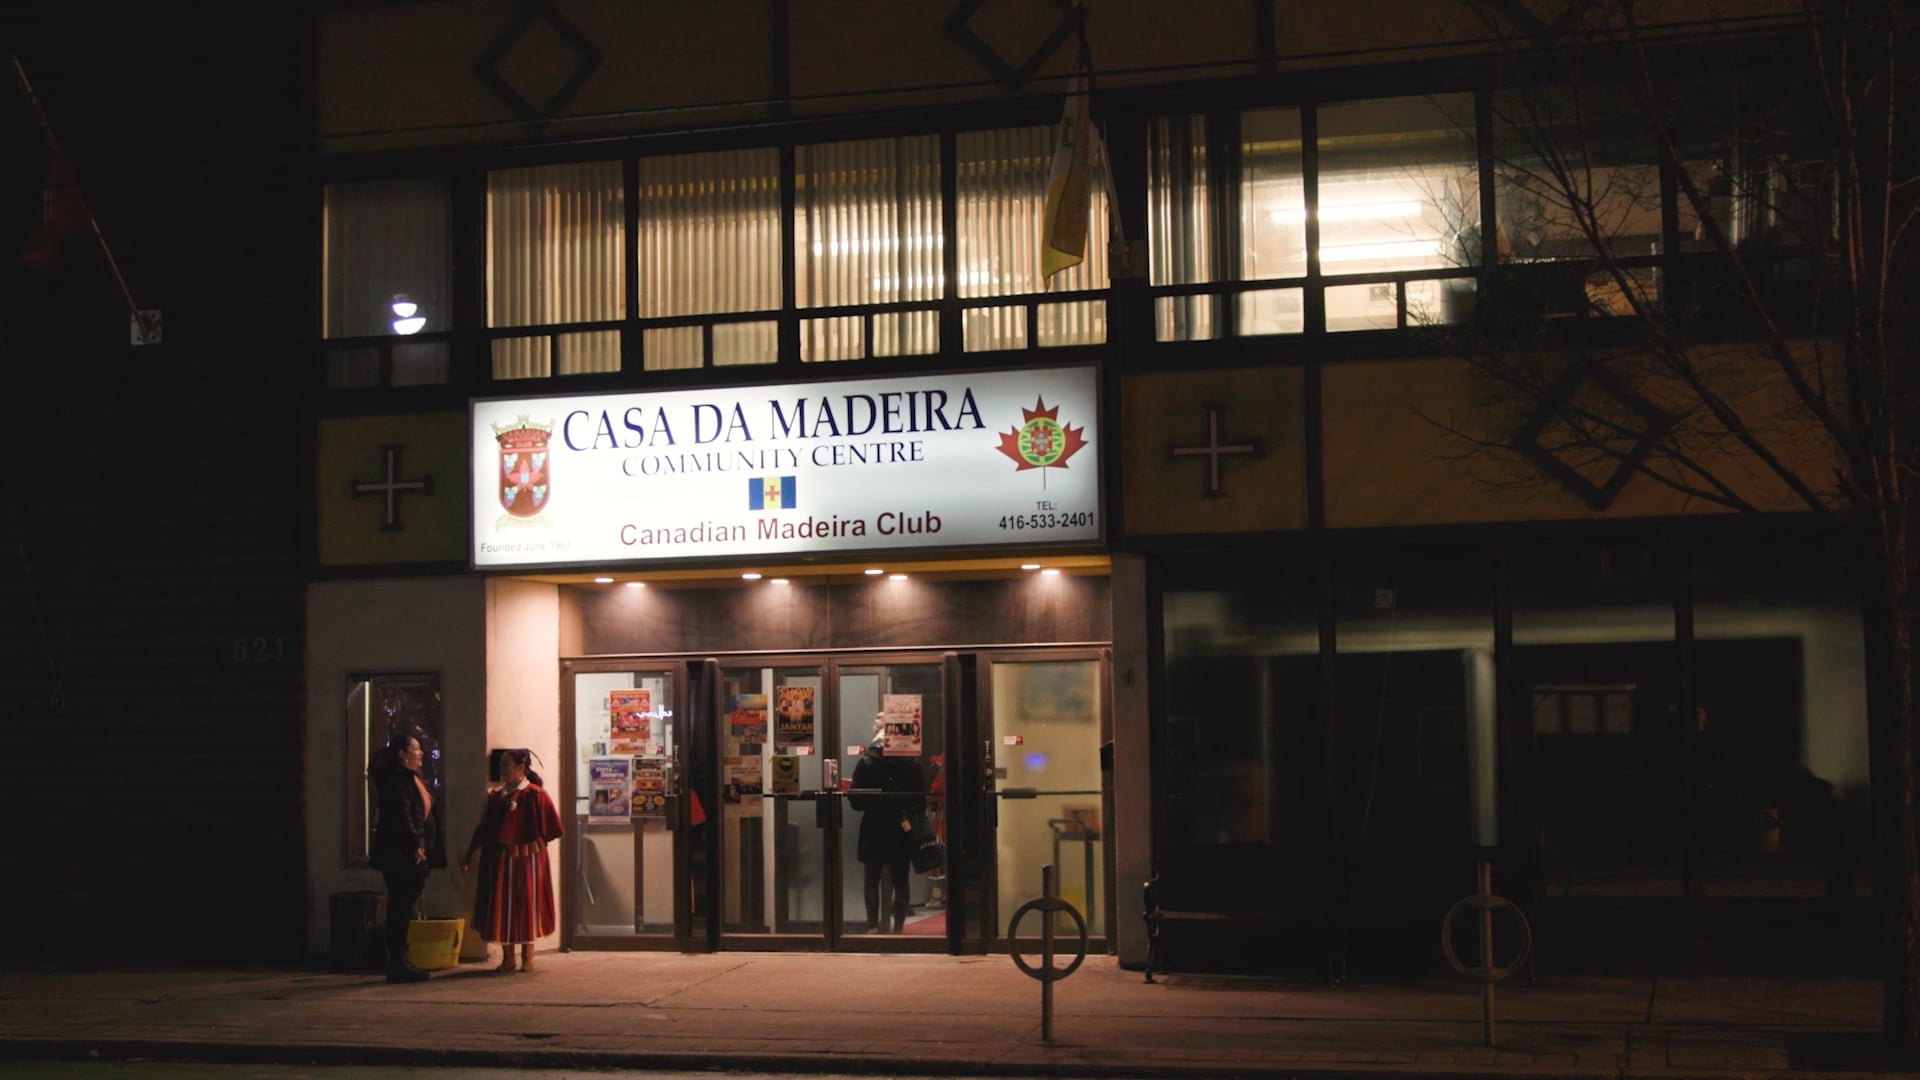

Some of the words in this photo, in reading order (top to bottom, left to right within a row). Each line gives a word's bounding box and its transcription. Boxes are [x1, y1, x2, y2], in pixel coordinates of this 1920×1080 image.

[563, 405, 677, 452] CASA
[690, 400, 755, 445] DA
[768, 386, 987, 440] MADEIRA
[622, 448, 803, 477] COMMUNITY
[811, 440, 924, 467] CENTRE
[1036, 501, 1058, 511] TEL:
[620, 521, 747, 546] Canadian
[757, 515, 867, 541] Madeira
[876, 509, 942, 536] Club
[999, 511, 1094, 530] 416-533-2401
[480, 541, 522, 553] Founded
[524, 541, 546, 553] June
[232, 636, 285, 663] 621
